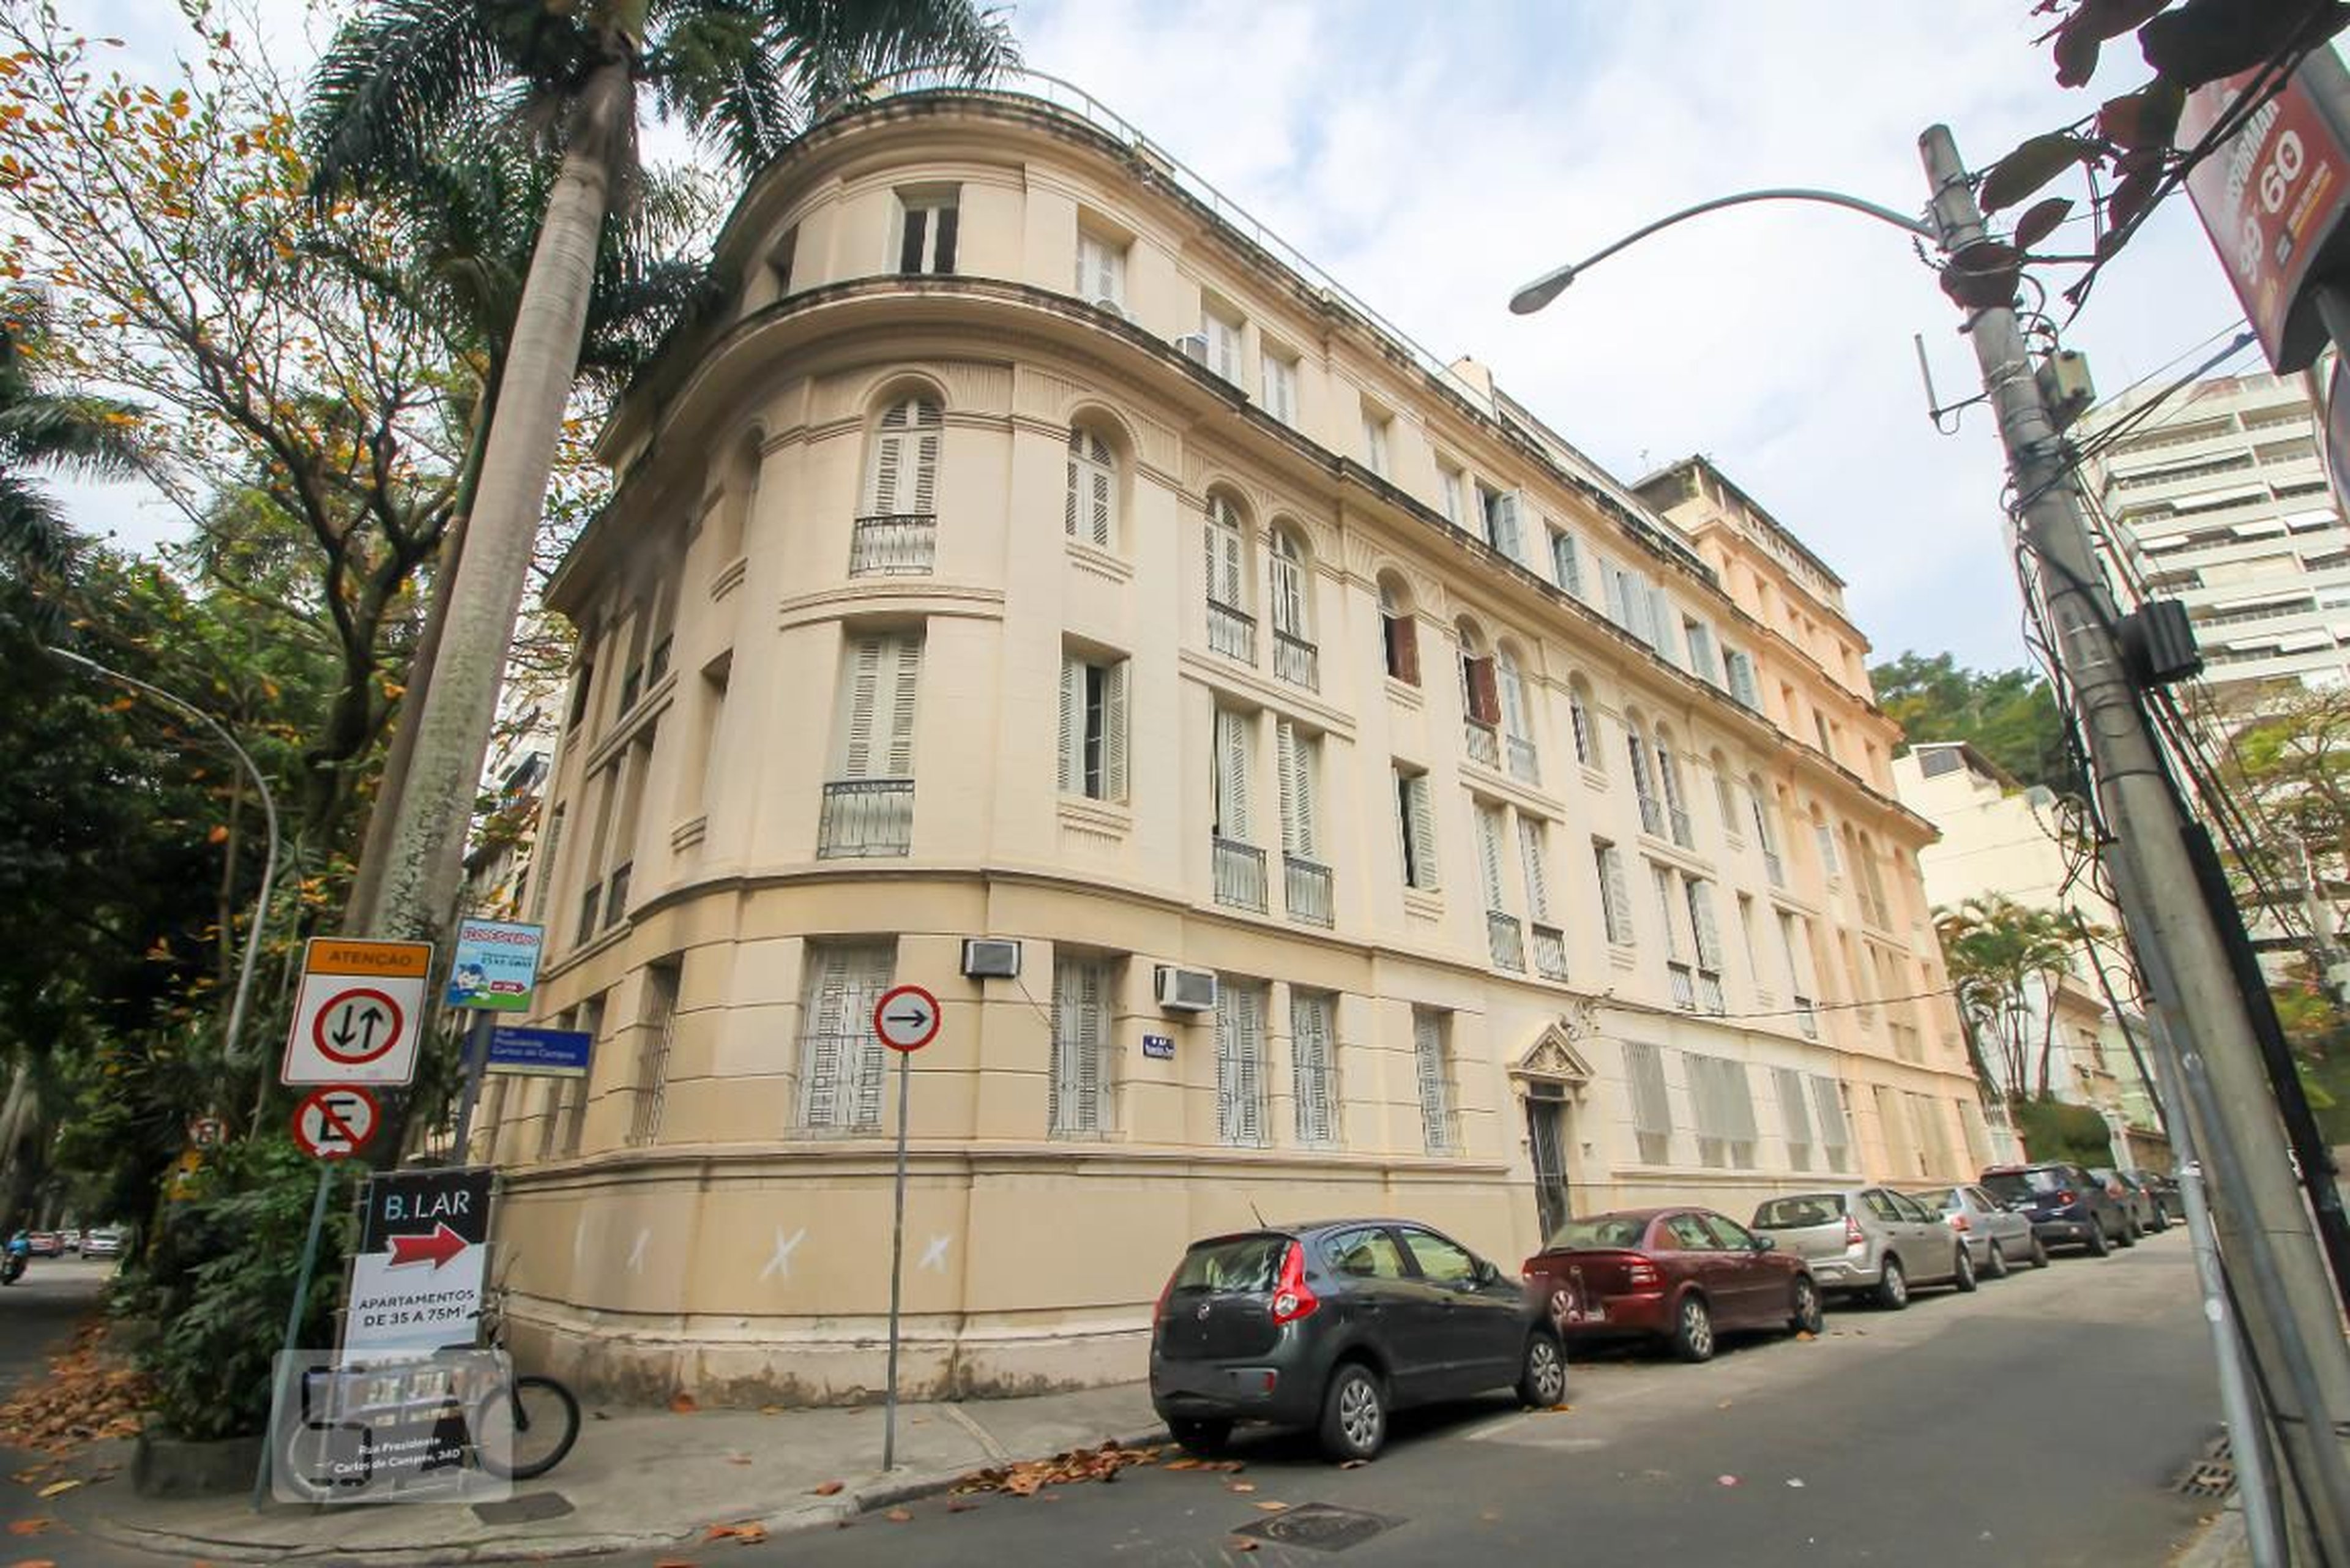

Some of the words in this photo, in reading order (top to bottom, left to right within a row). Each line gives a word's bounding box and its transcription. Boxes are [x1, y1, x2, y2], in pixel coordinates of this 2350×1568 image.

[329, 950, 412, 968] ATENÇÃO
[319, 1099, 357, 1142] E
[359, 1290, 475, 1310] APARTAMENTOS
[364, 1314, 386, 1327] DE
[389, 1313, 409, 1324] 35
[412, 1311, 424, 1323] A
